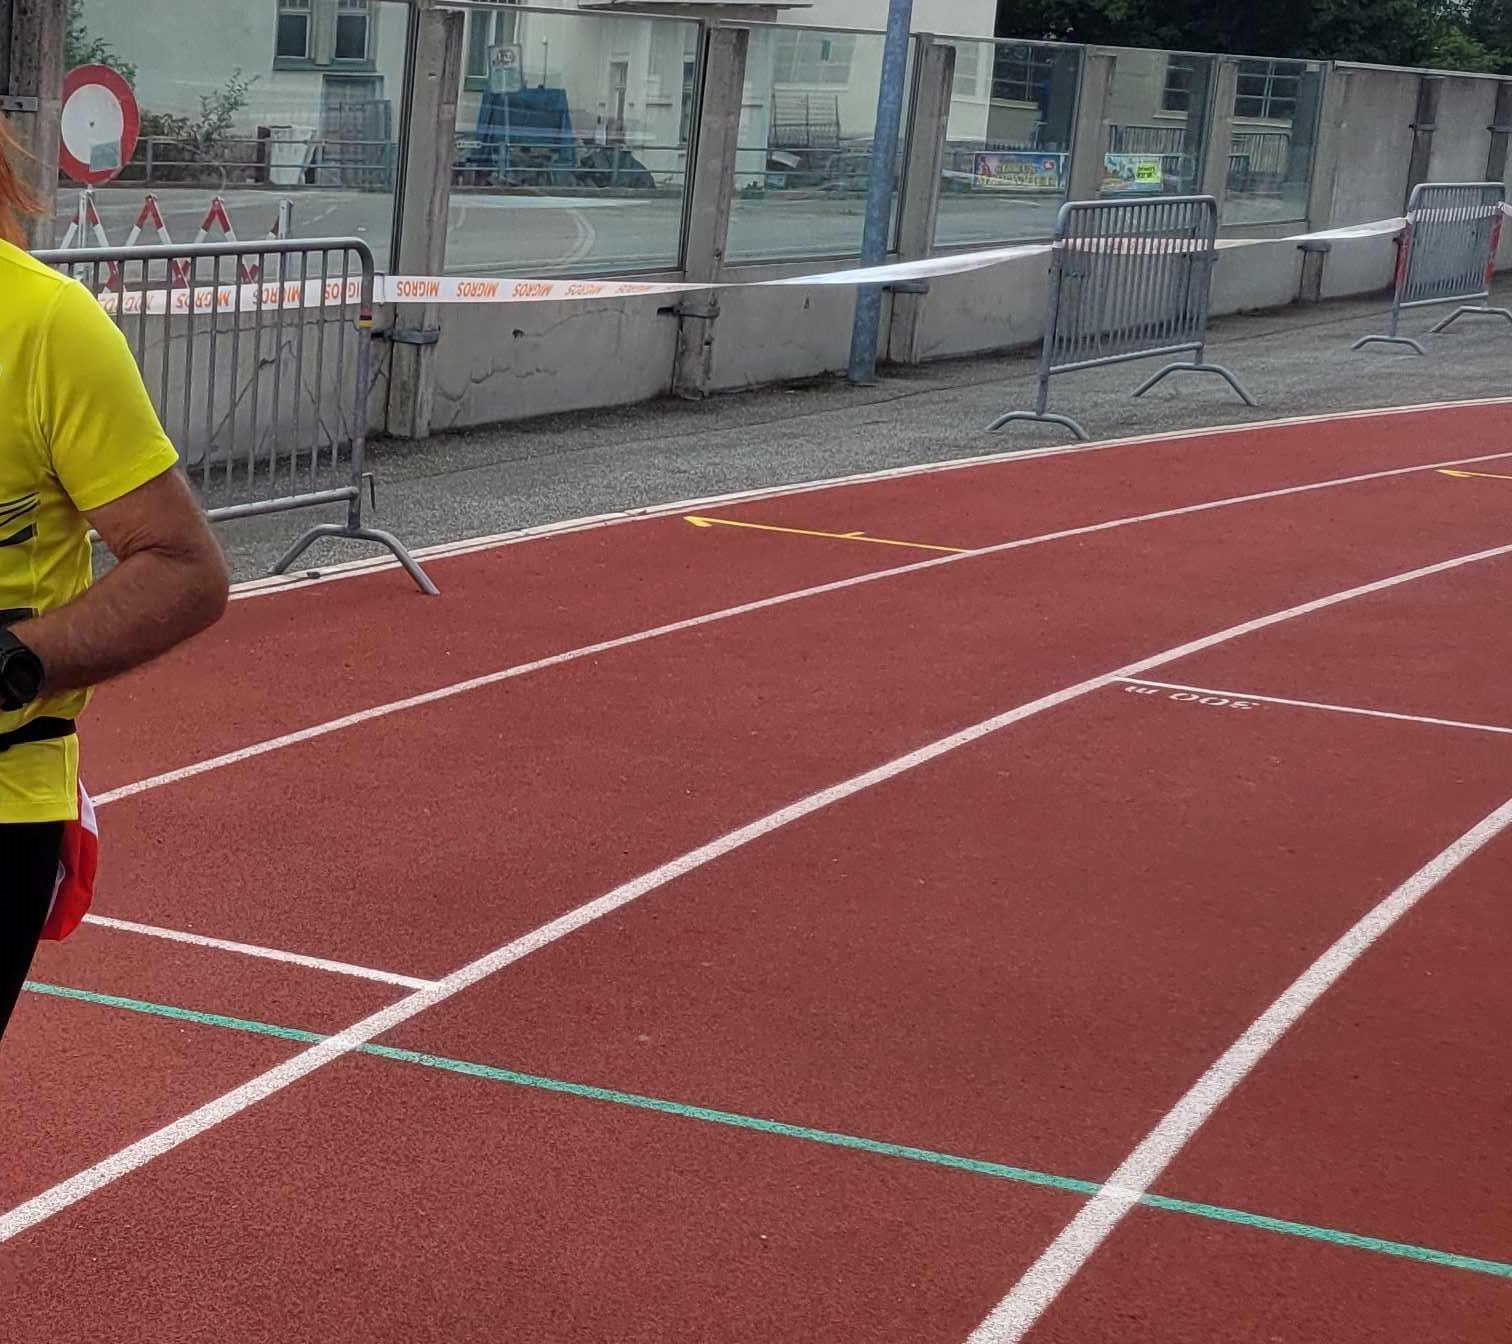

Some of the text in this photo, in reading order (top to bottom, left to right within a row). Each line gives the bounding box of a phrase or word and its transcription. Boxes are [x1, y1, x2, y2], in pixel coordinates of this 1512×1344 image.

[252, 287, 301, 305] MIROS
[324, 281, 360, 301] IGOS
[396, 280, 440, 297] MIGROS
[456, 281, 499, 298] MIGROS
[1168, 692, 1262, 710] 300
